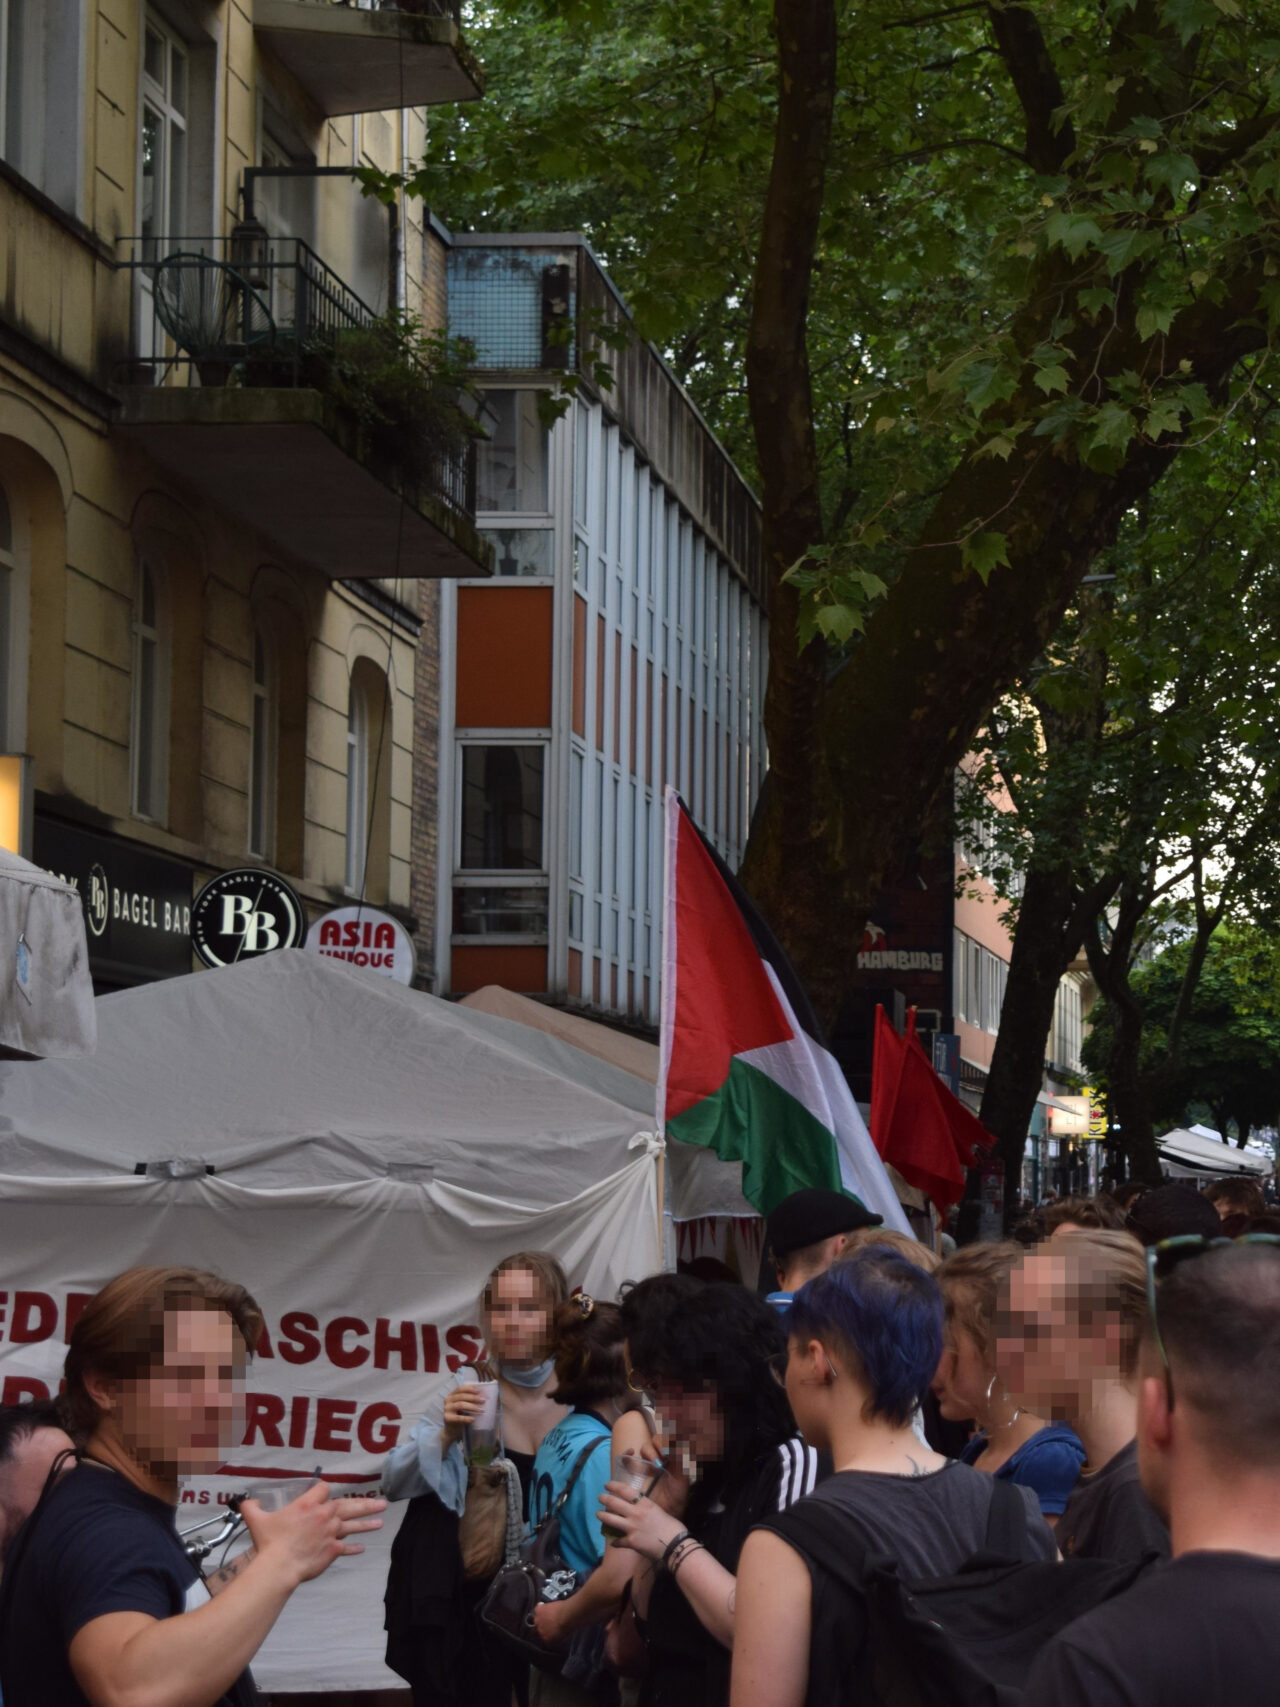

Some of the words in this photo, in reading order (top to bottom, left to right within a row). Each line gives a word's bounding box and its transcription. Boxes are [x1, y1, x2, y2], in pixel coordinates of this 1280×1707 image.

[113, 887, 157, 928] BAGEL
[164, 901, 191, 935] BAR
[199, 888, 218, 913] YORK
[222, 875, 255, 888] BAGEL
[261, 878, 281, 892] BAR
[219, 894, 280, 952] BB
[319, 919, 396, 949] ASIA
[857, 950, 943, 971] HAMBURG
[255, 1308, 487, 1376] ASCHIS
[241, 1392, 402, 1454] RIEG
